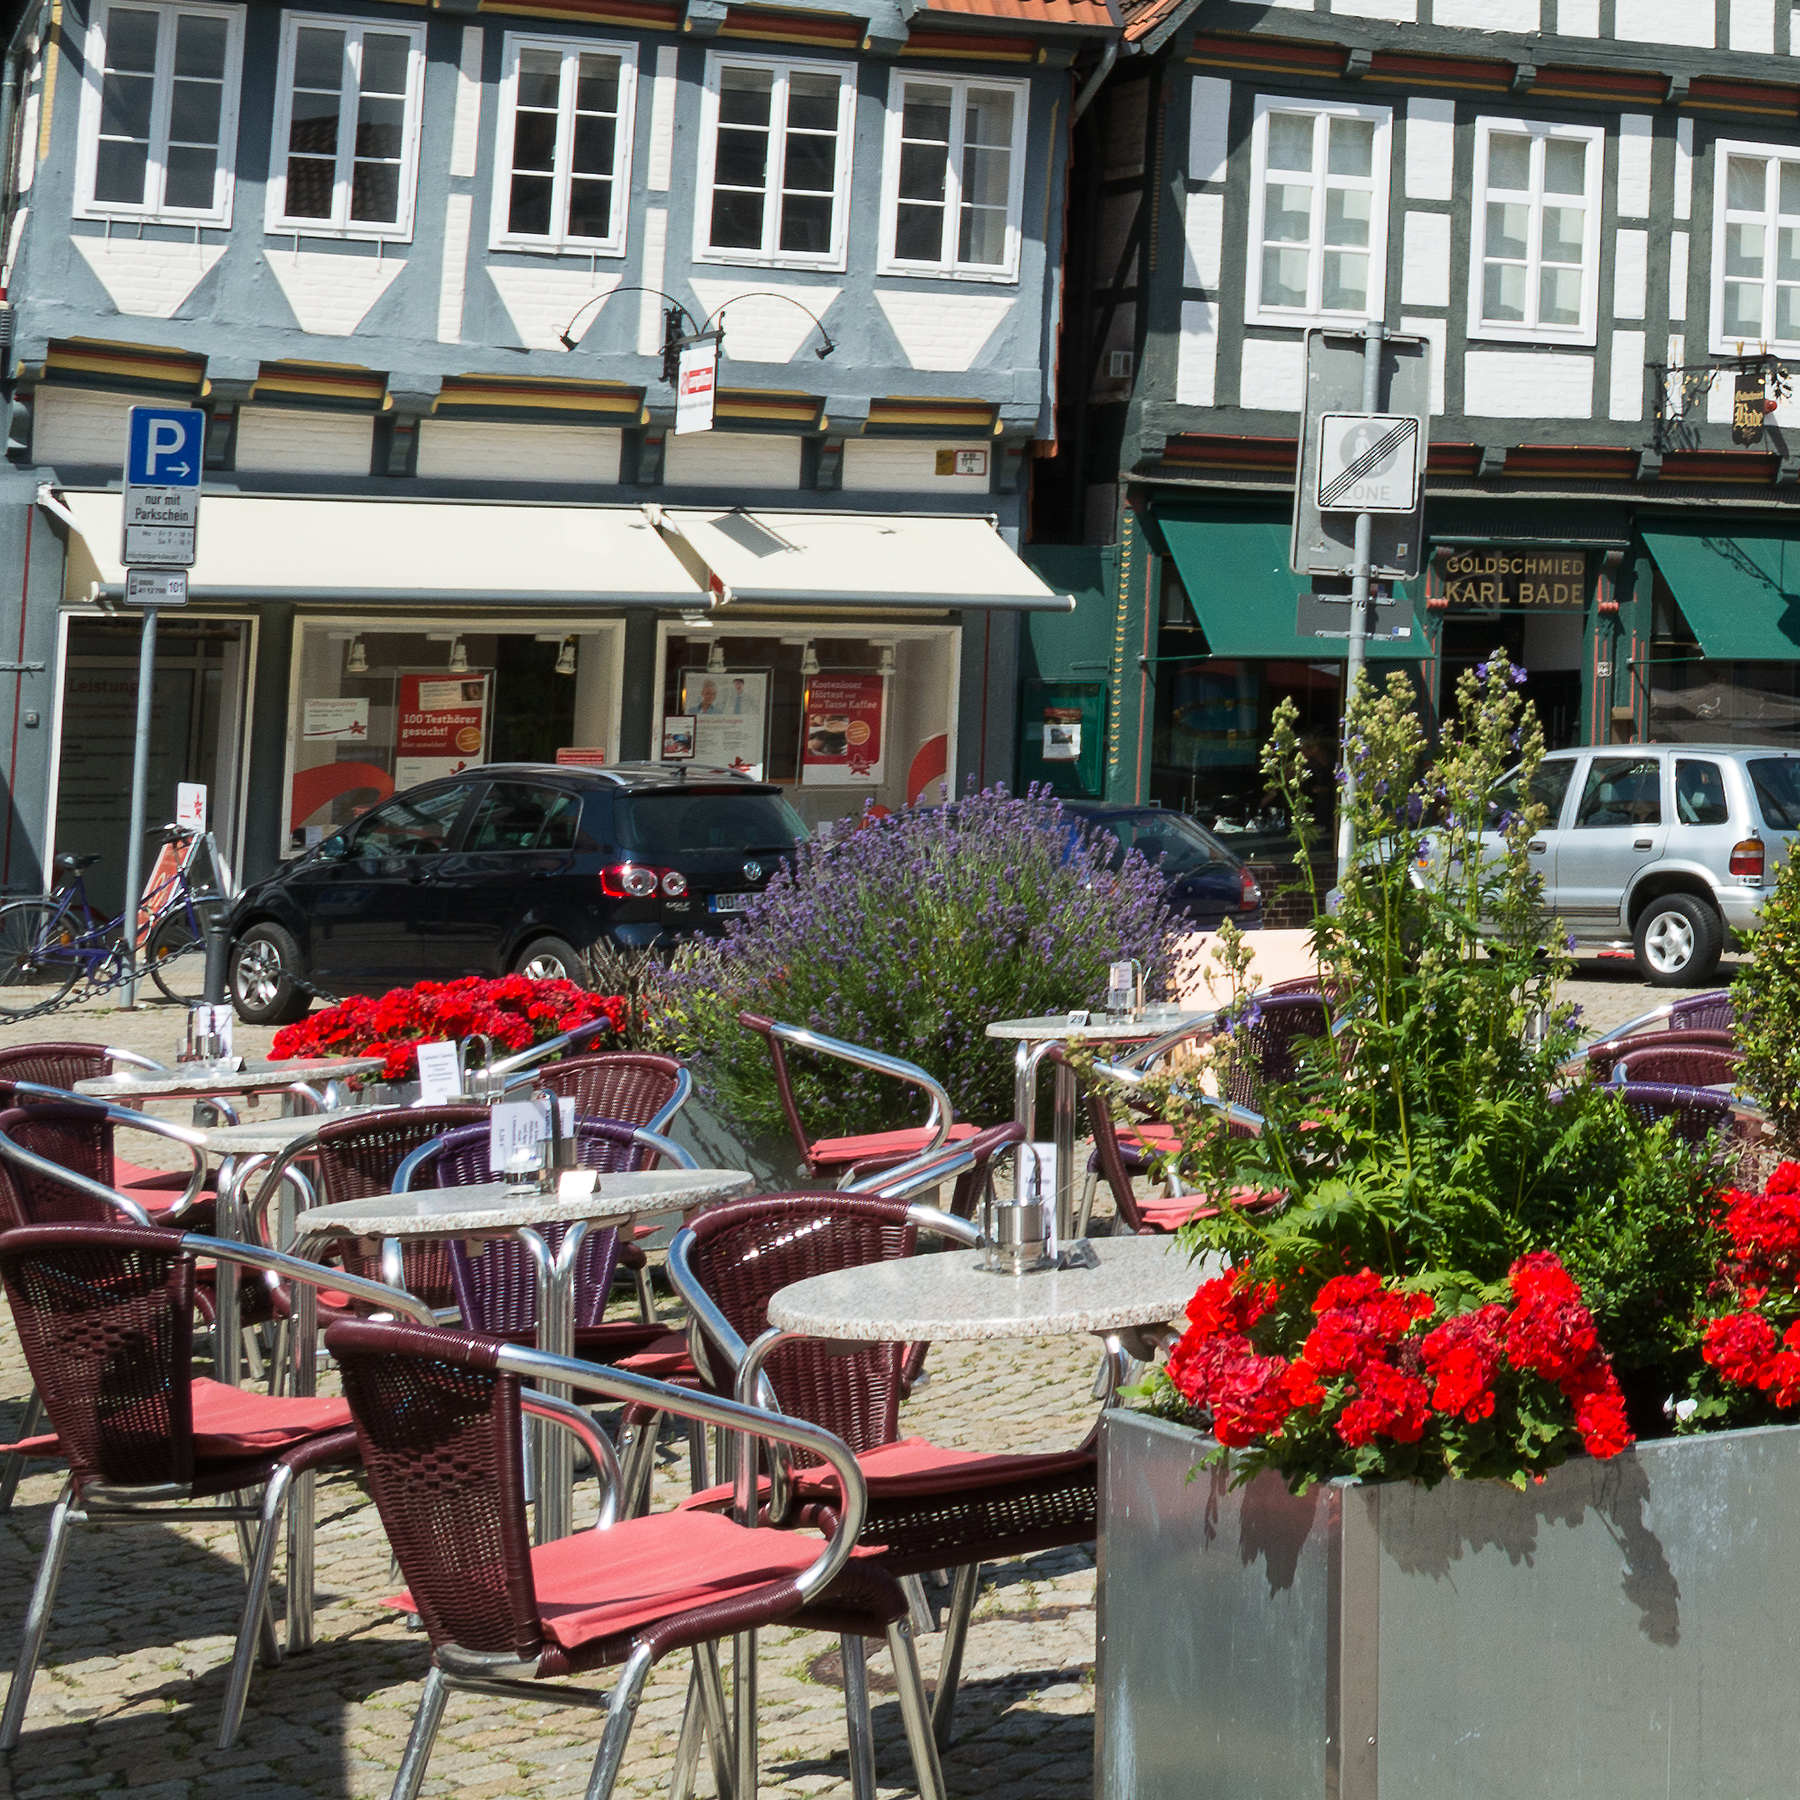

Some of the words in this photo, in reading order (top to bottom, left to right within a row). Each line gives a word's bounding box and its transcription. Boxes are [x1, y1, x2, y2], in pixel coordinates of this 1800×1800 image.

[146, 418, 187, 476] P
[1341, 484, 1391, 501] ZONE
[145, 495, 162, 506] nur
[164, 494, 181, 506] mit
[135, 507, 188, 521] Parkschein
[1446, 556, 1585, 576] GOLDSCHMIED
[1445, 581, 1511, 604] KARL
[1518, 582, 1585, 605] BADE
[848, 700, 878, 709] Kaffee
[403, 713, 423, 724] 100
[425, 713, 478, 724] Testhörer
[402, 725, 449, 738] gesucht!
